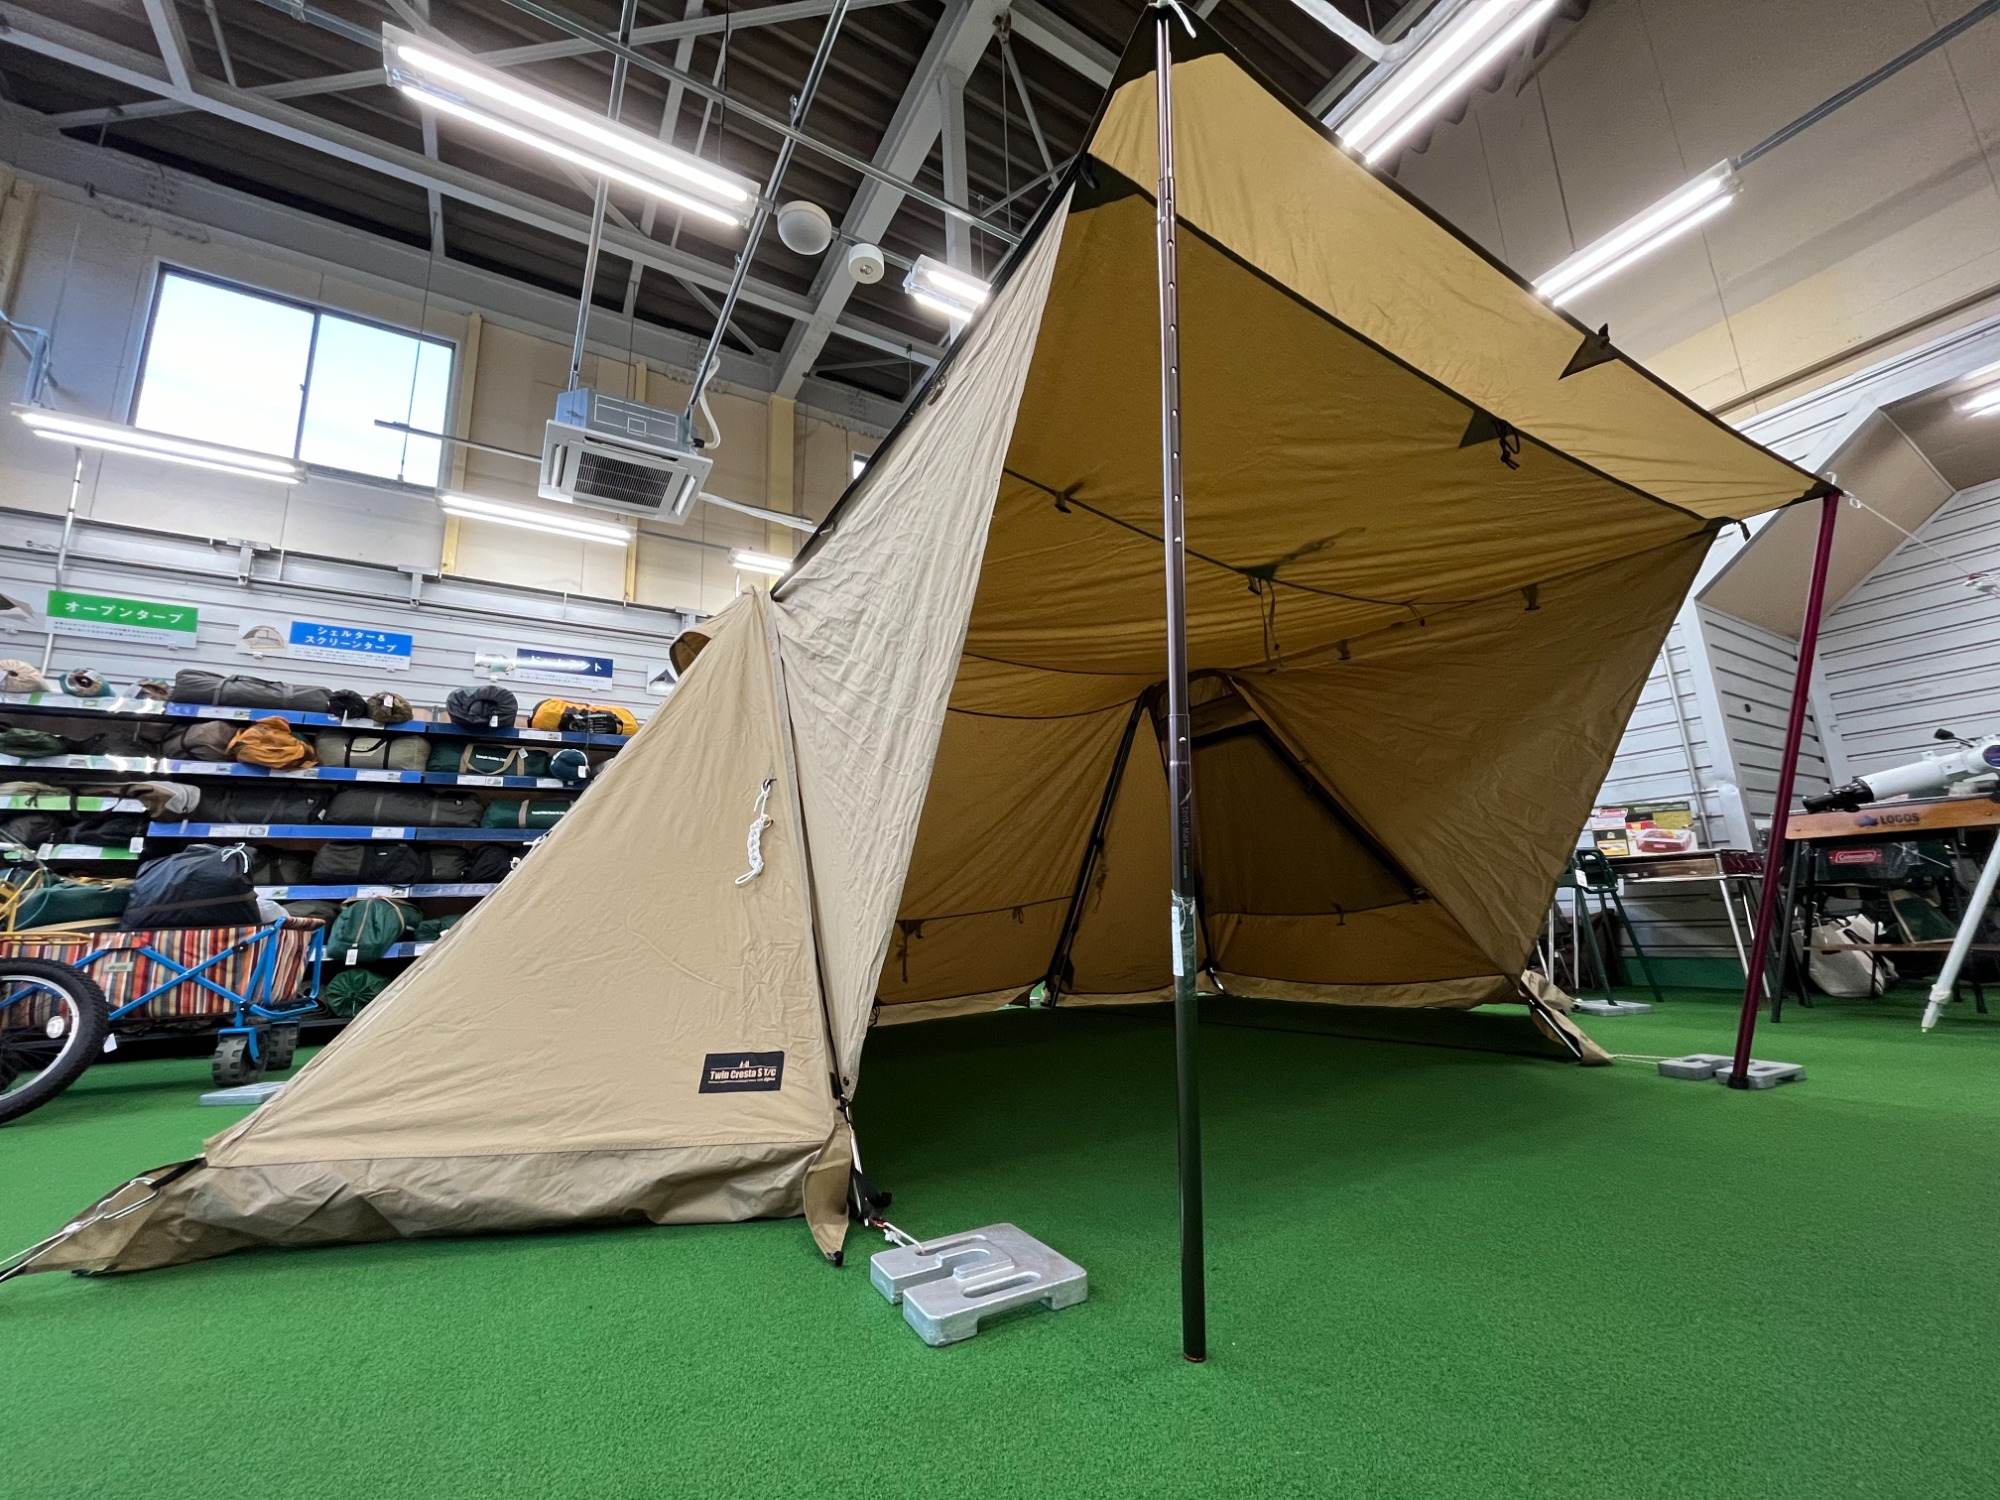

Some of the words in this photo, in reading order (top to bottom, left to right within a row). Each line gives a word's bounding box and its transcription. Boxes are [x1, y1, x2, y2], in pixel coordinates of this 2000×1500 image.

[304, 635, 397, 653] スクリーンタープ
[1879, 812, 1920, 825] LOGOS
[710, 1070, 729, 1080] Twin
[757, 1068, 762, 1077] S
[764, 1068, 776, 1077] T/C
